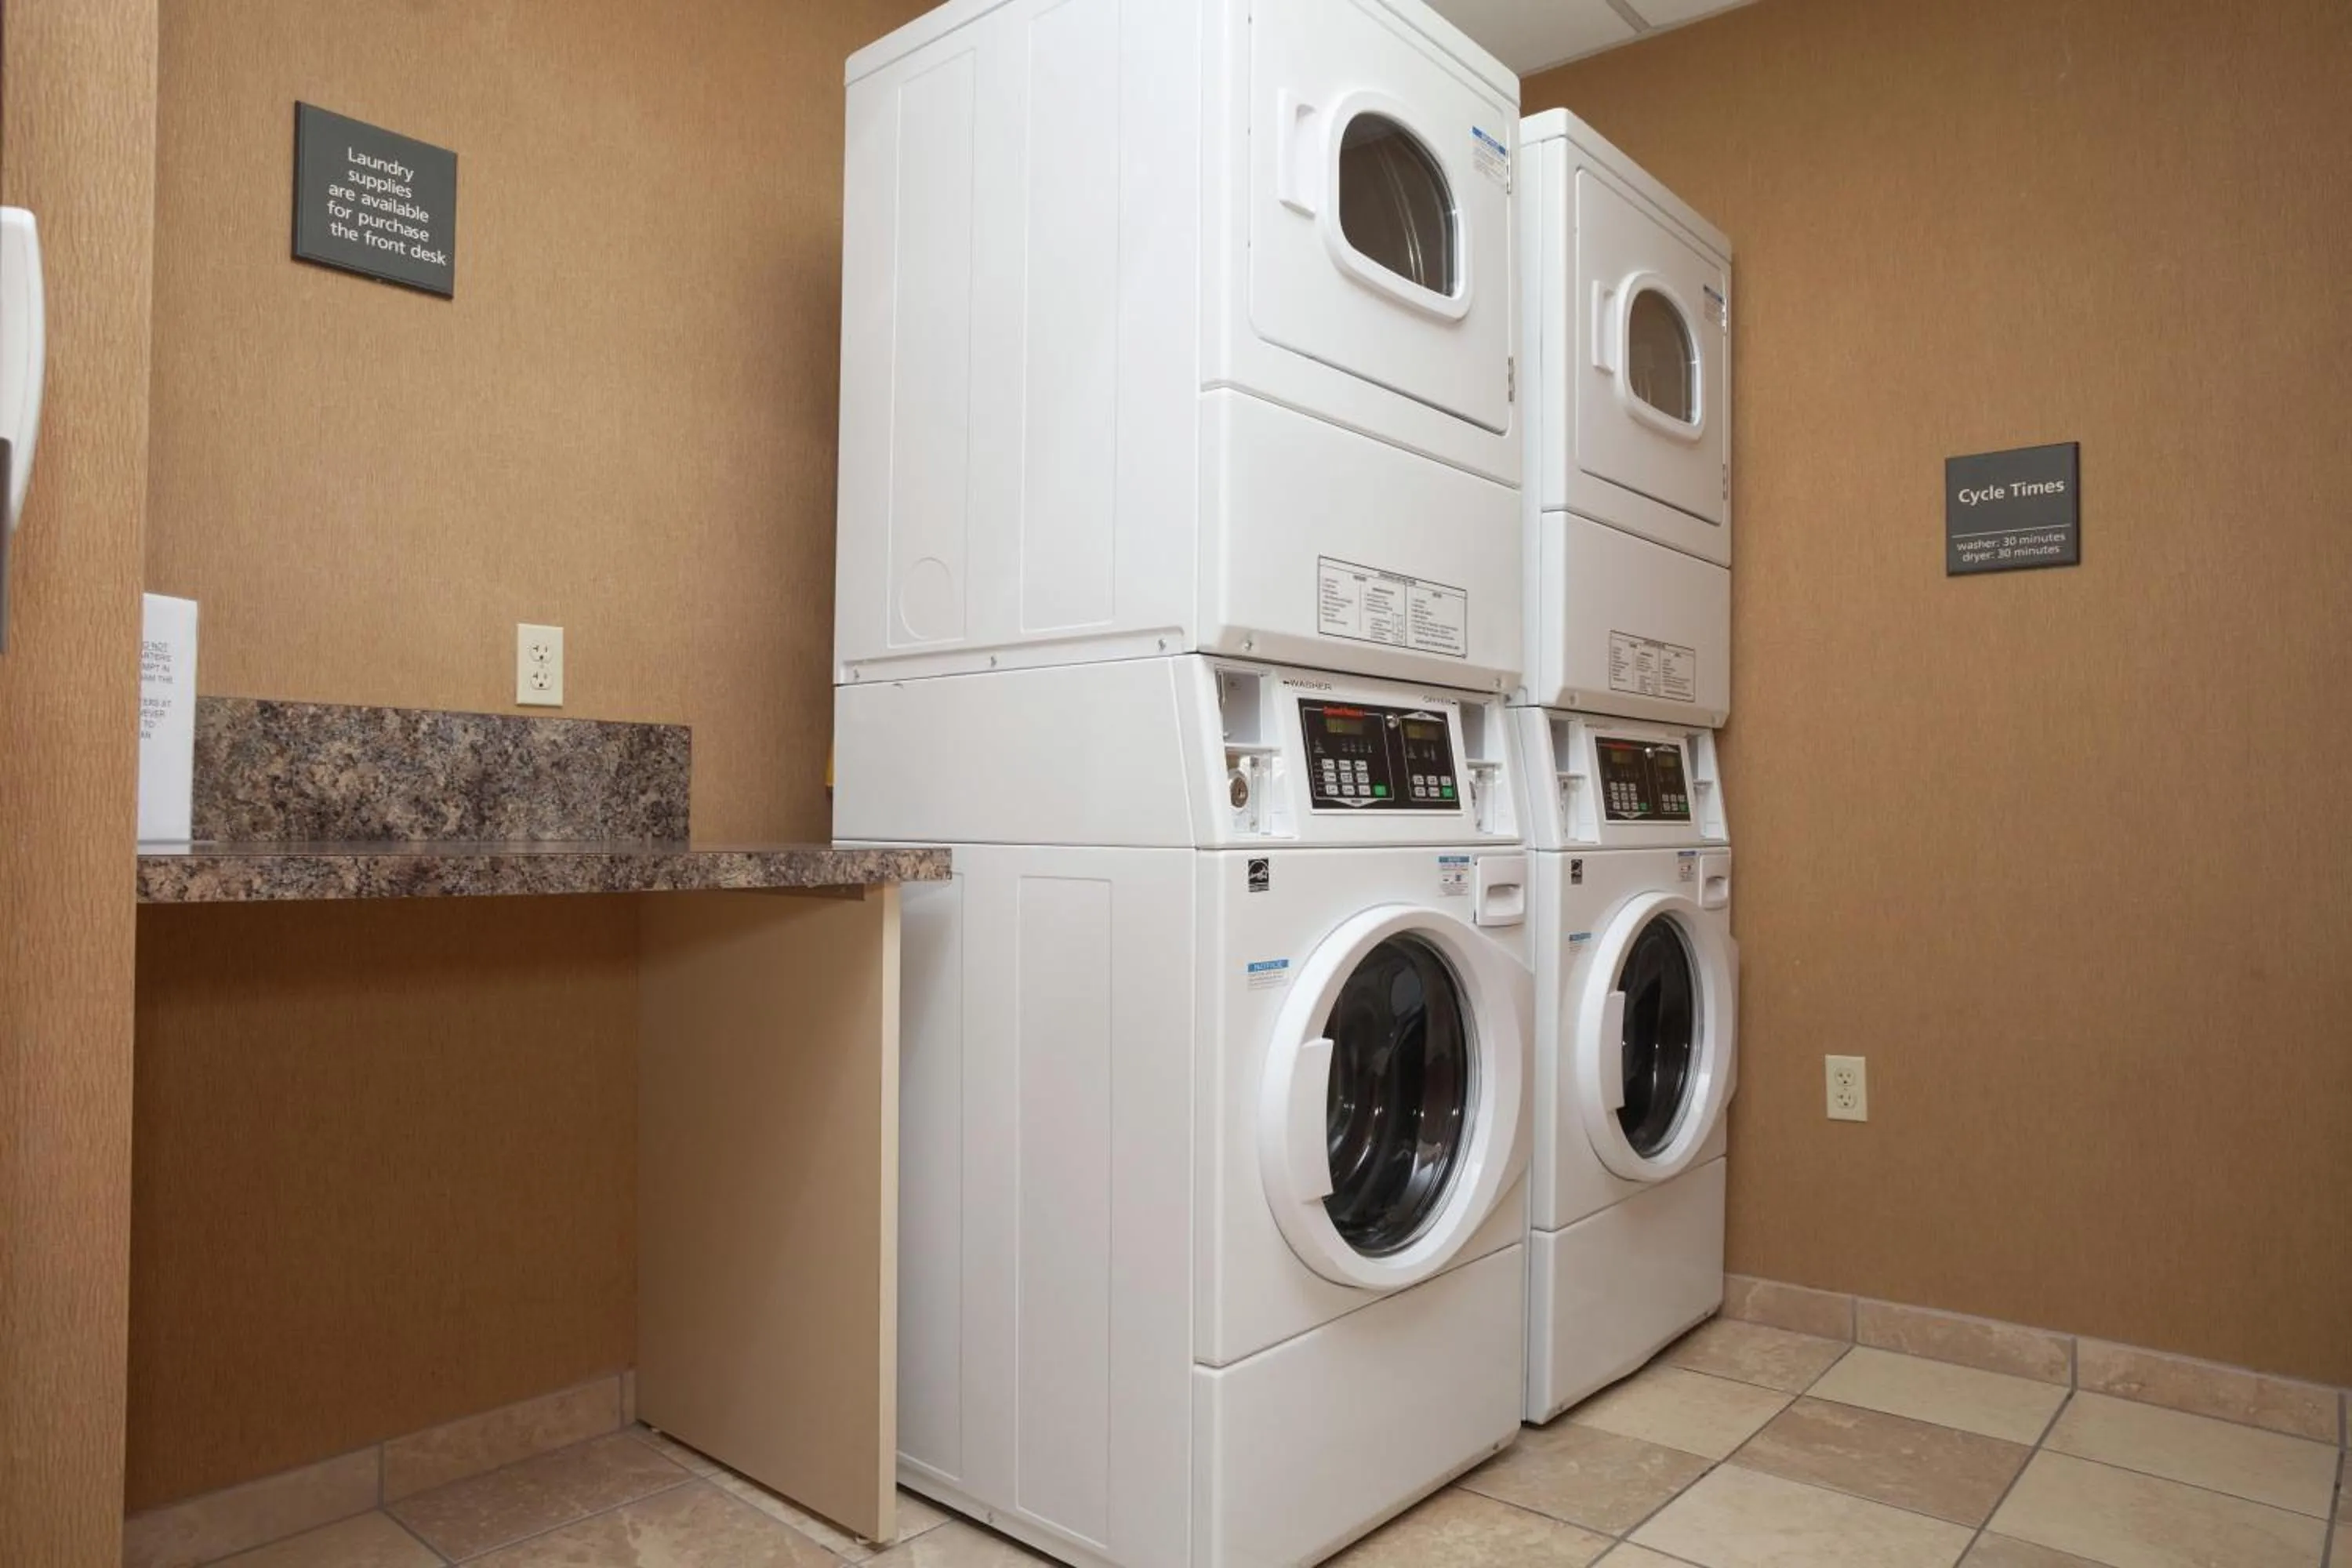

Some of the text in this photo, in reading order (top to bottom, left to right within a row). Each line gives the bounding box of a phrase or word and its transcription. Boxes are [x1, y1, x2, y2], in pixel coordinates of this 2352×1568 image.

[347, 147, 414, 182] Laundry
[347, 169, 412, 198] supplies
[328, 184, 429, 223] are available
[328, 201, 430, 242] for purchase
[330, 222, 447, 267] the front desk
[1958, 480, 2065, 506] Cycle Times
[1956, 532, 2067, 551] washer: 30 minutes
[1962, 545, 2060, 563] dryer: 30 minutes
[1289, 680, 1332, 691] WASHER
